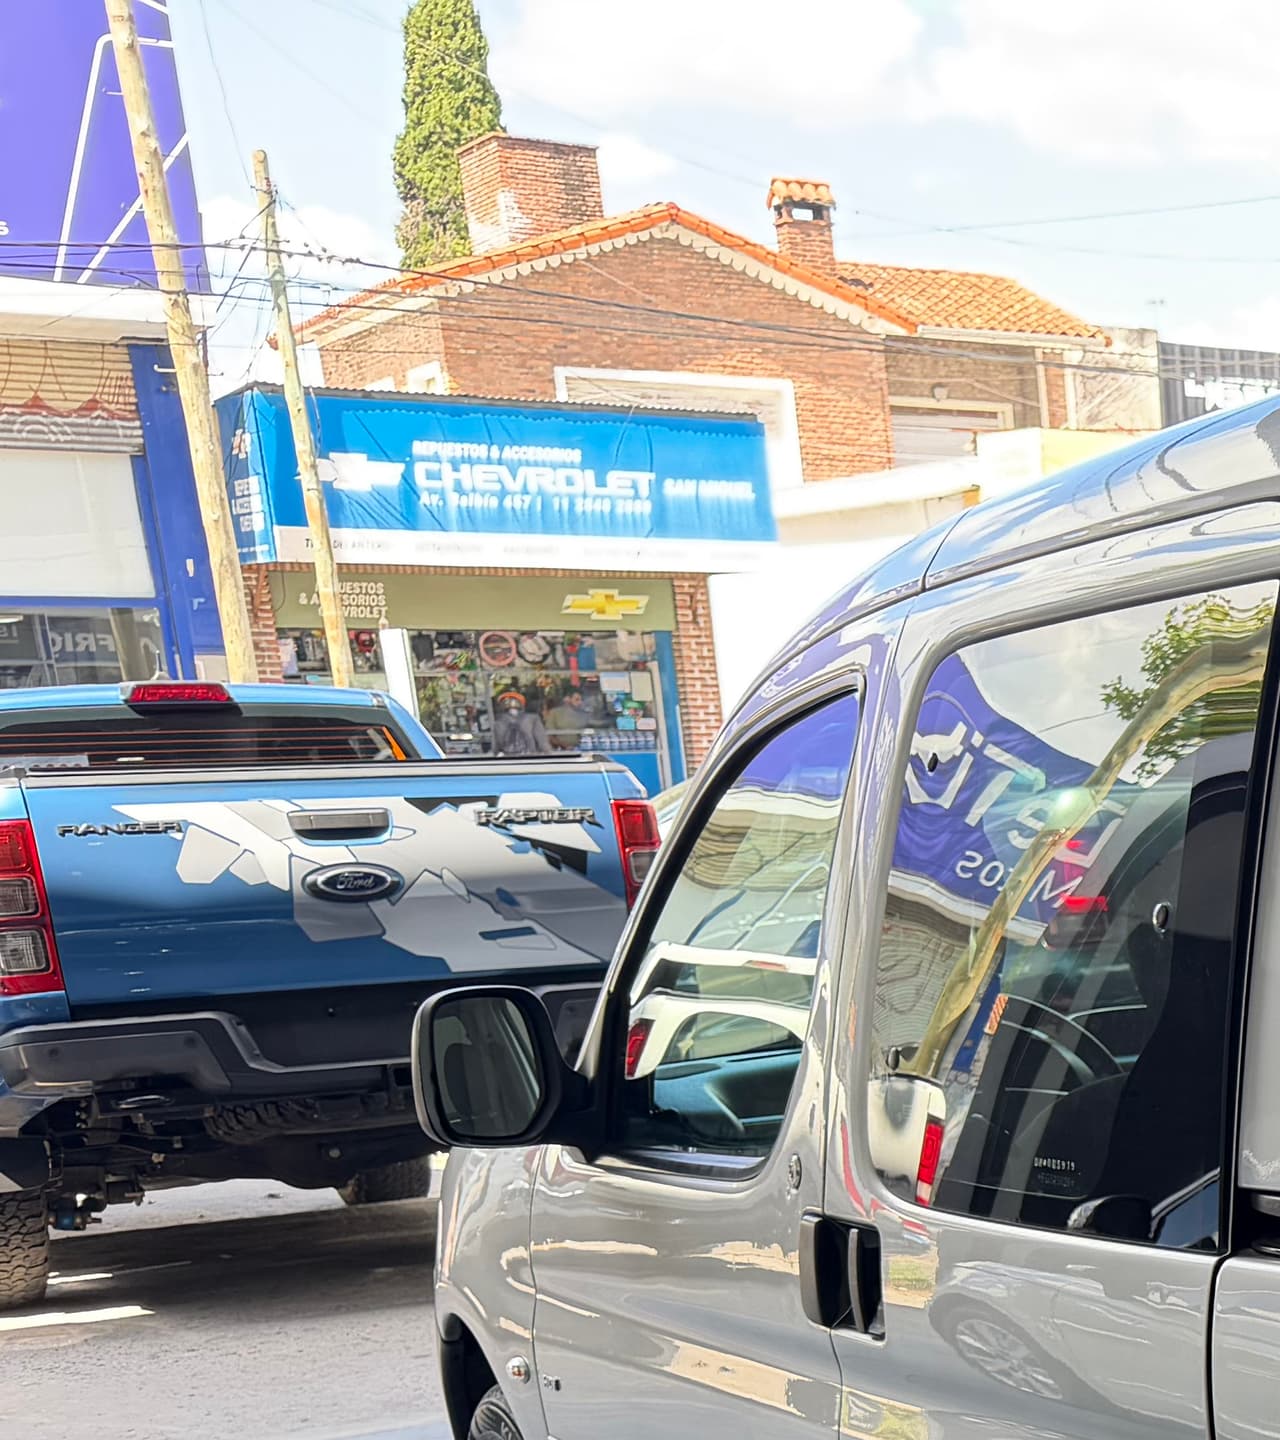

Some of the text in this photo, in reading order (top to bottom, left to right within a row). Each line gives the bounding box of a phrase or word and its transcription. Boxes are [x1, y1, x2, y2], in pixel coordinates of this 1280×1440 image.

[412, 440, 489, 459] REPUESTOS
[413, 461, 656, 499] CHEVROLET
[477, 807, 605, 830] RAPTOR
[57, 820, 184, 838] RANGER
[335, 872, 375, 889] Ford
